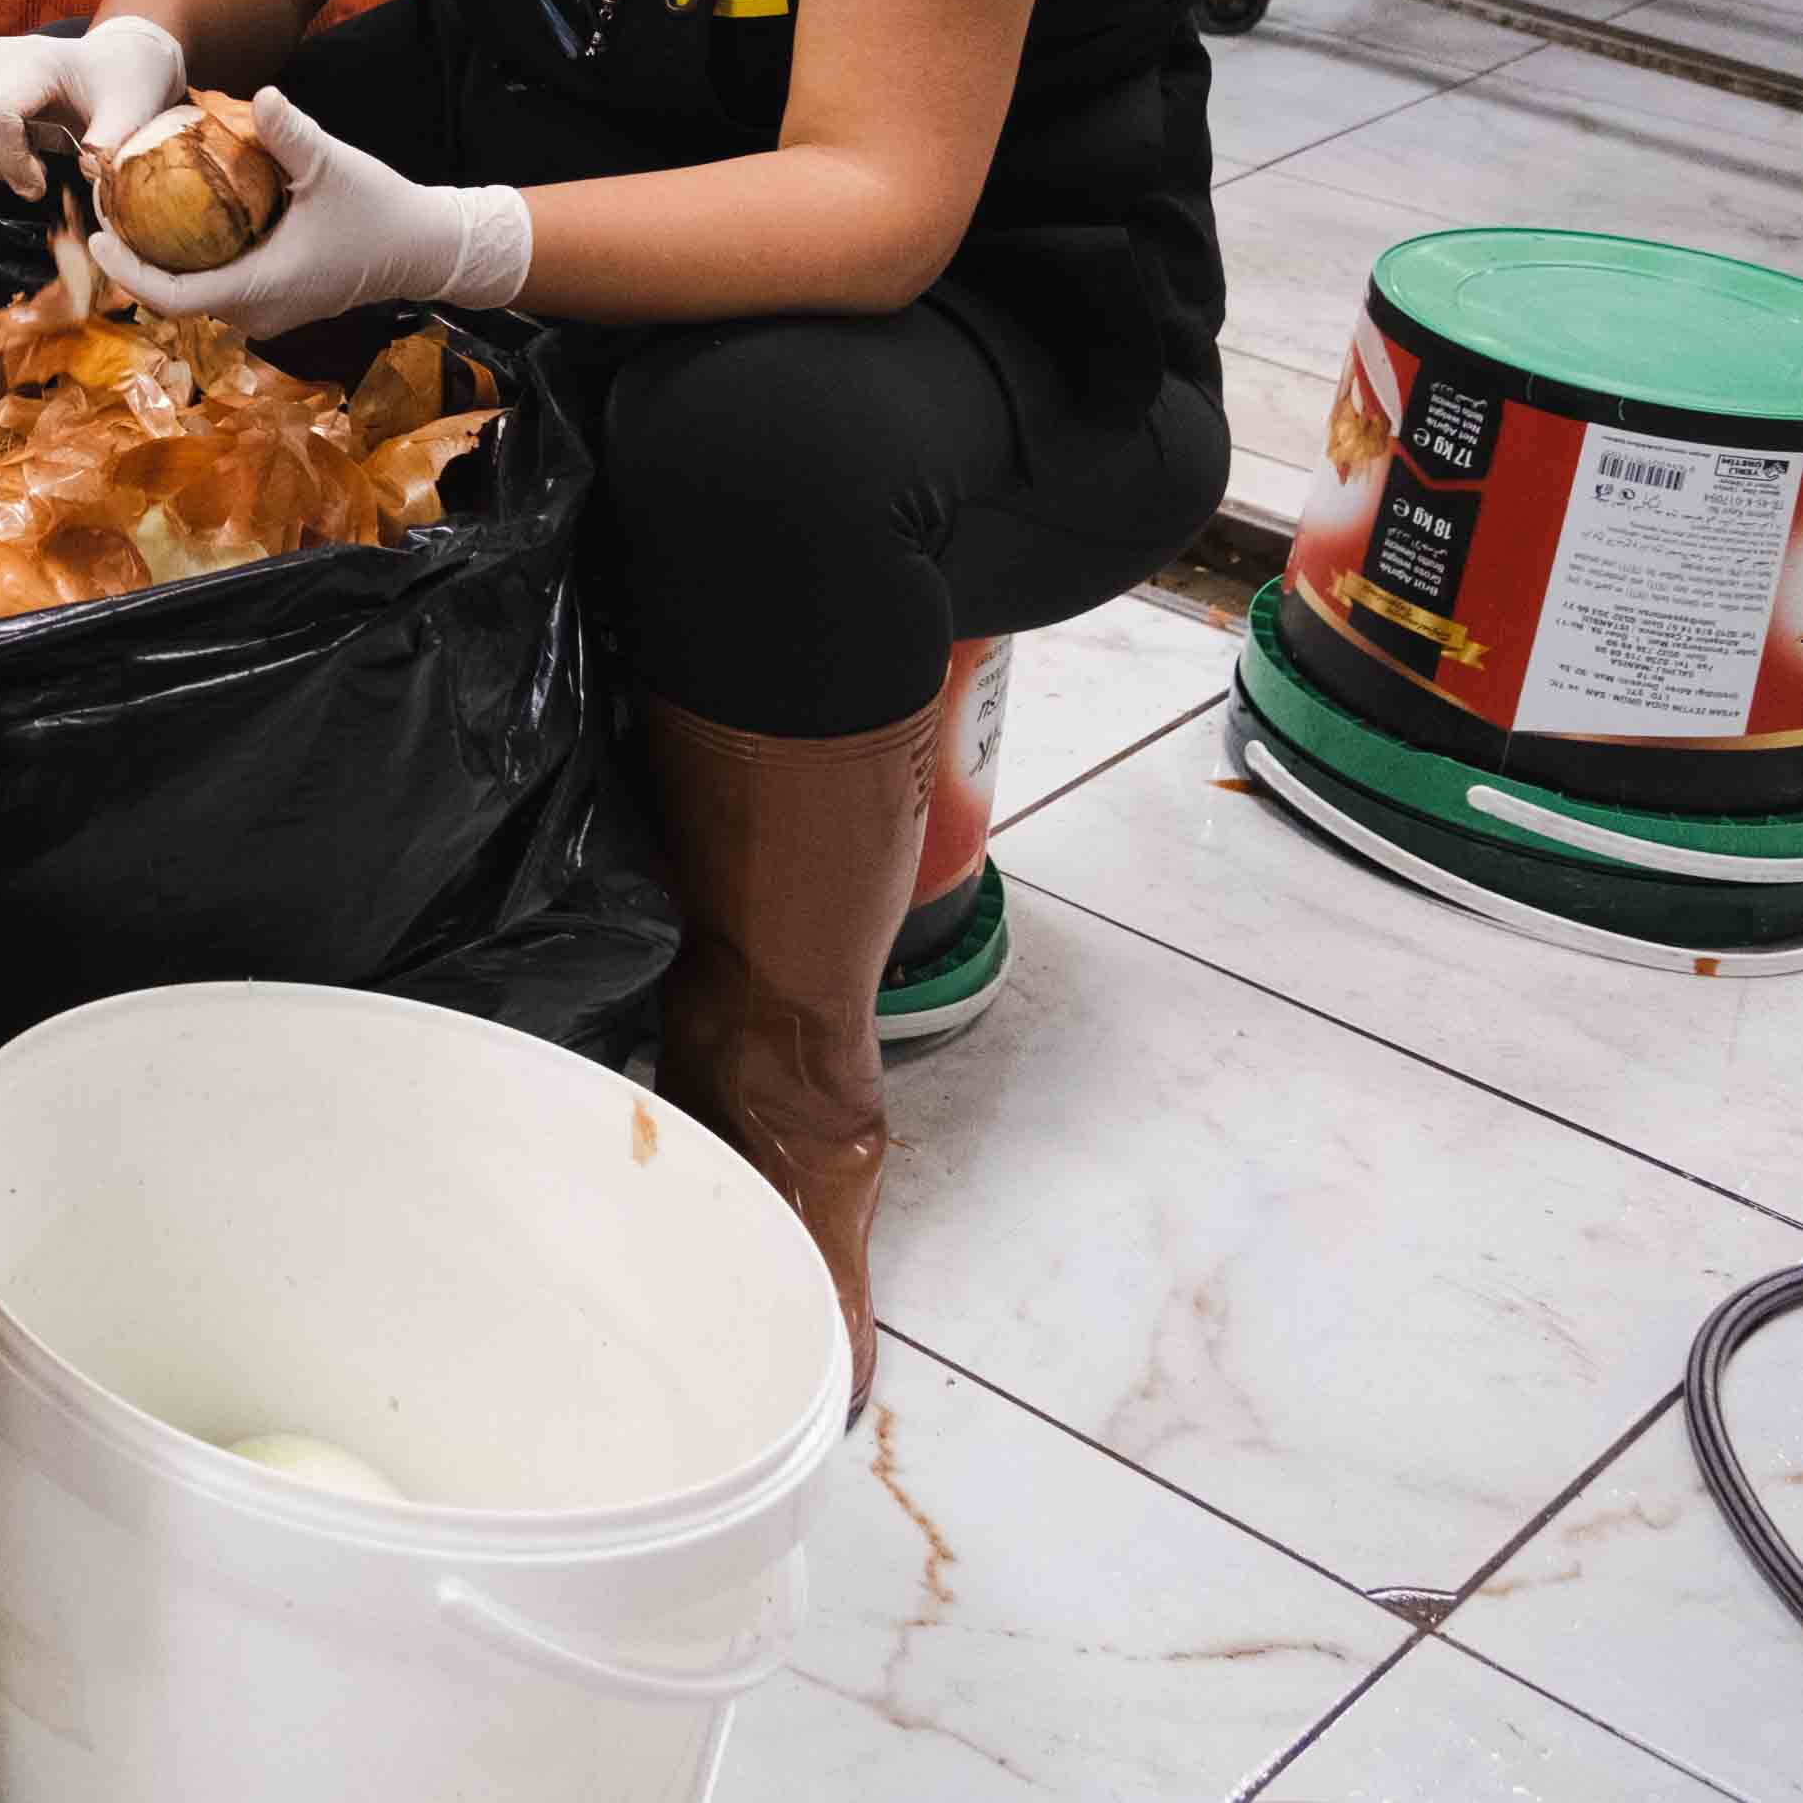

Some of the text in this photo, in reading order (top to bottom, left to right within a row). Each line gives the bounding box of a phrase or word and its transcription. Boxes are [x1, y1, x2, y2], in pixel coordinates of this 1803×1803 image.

[1433, 435, 1454, 461] kg
[1453, 447, 1473, 468] 17
[1412, 507, 1434, 532] kg
[1433, 518, 1453, 540] 18
